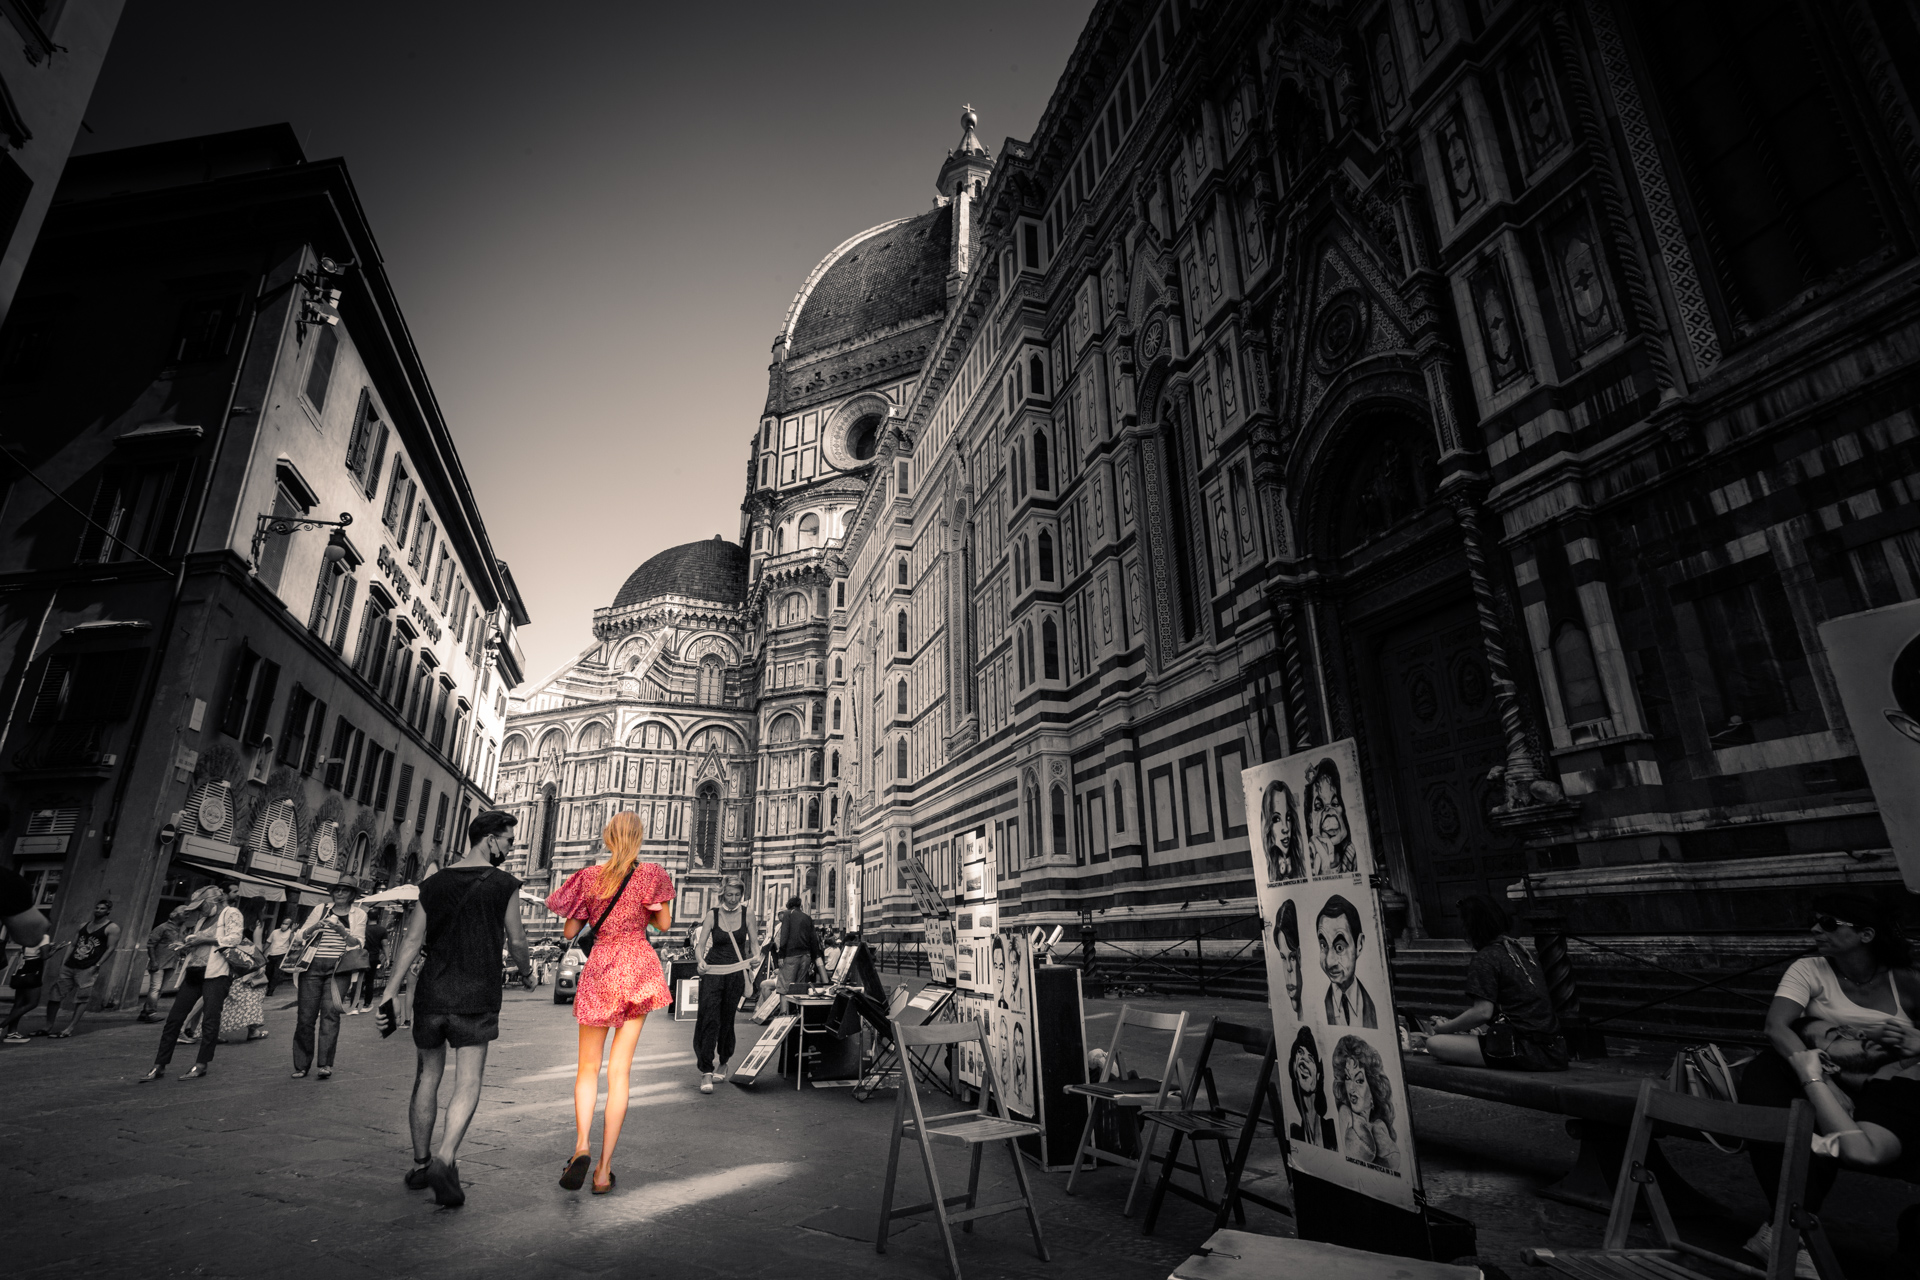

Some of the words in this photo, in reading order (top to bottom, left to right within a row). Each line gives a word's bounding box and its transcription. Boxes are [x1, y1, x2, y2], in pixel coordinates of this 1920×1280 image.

[377, 544, 411, 604] HOTEL
[412, 596, 442, 645] DUOMO
[1346, 1156, 1366, 1167] CARICATURA
